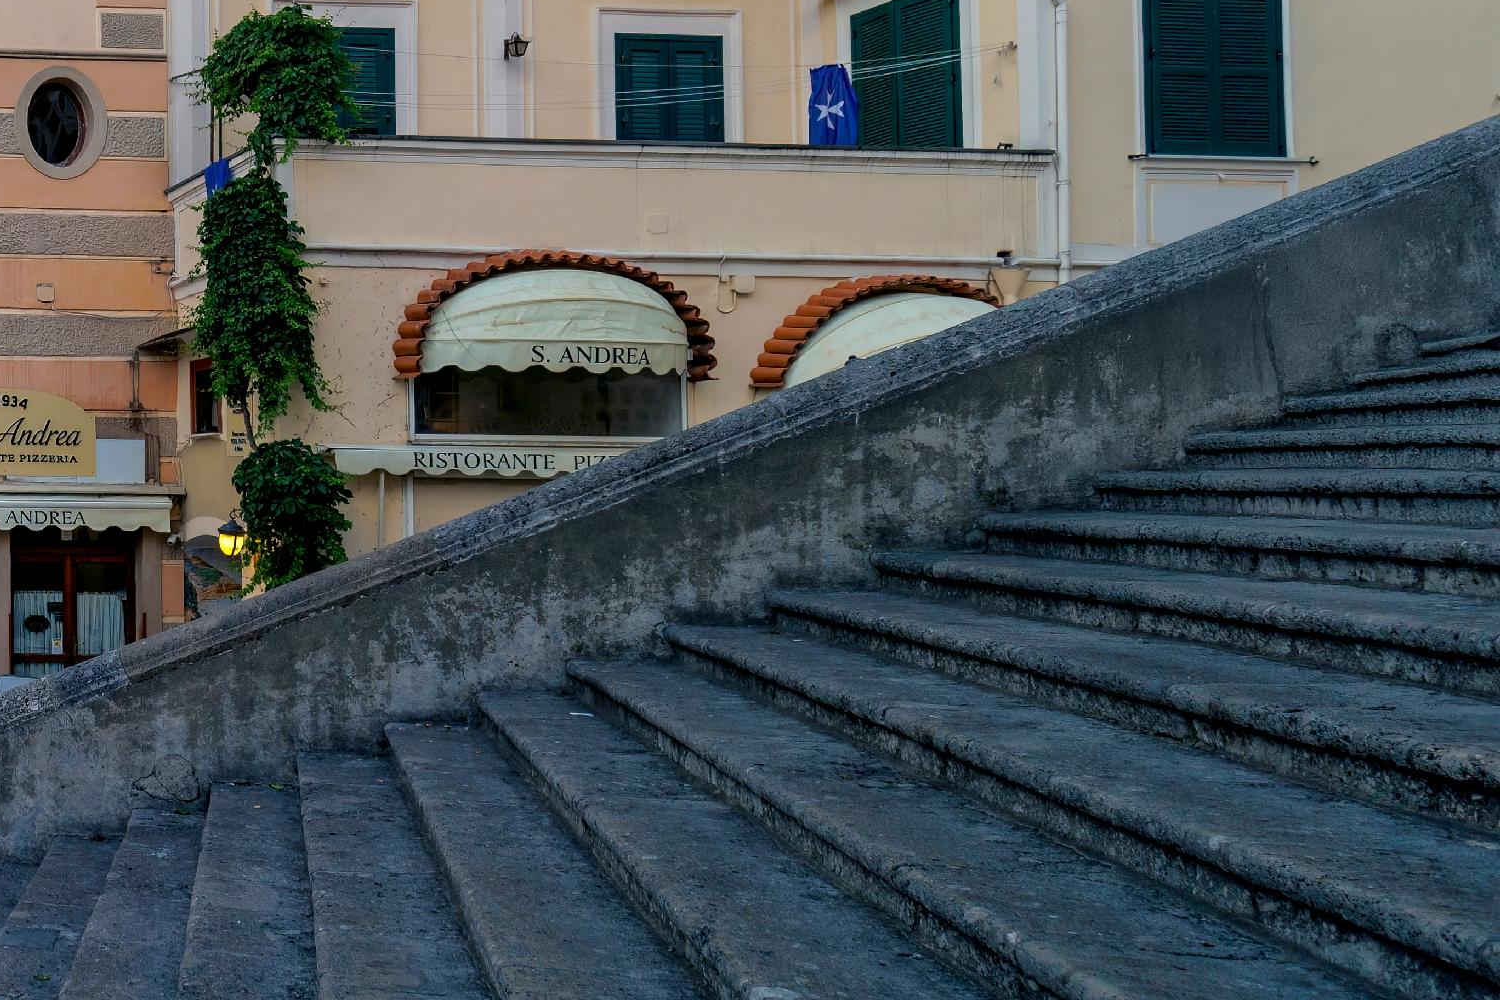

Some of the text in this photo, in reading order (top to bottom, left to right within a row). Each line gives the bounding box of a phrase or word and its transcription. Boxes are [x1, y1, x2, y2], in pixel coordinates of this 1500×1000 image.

[531, 345, 650, 365] S. ANDREA
[19, 454, 78, 464] PIZZERIA
[413, 451, 556, 470] RISTORANTE
[6, 510, 86, 526] ANDREA
